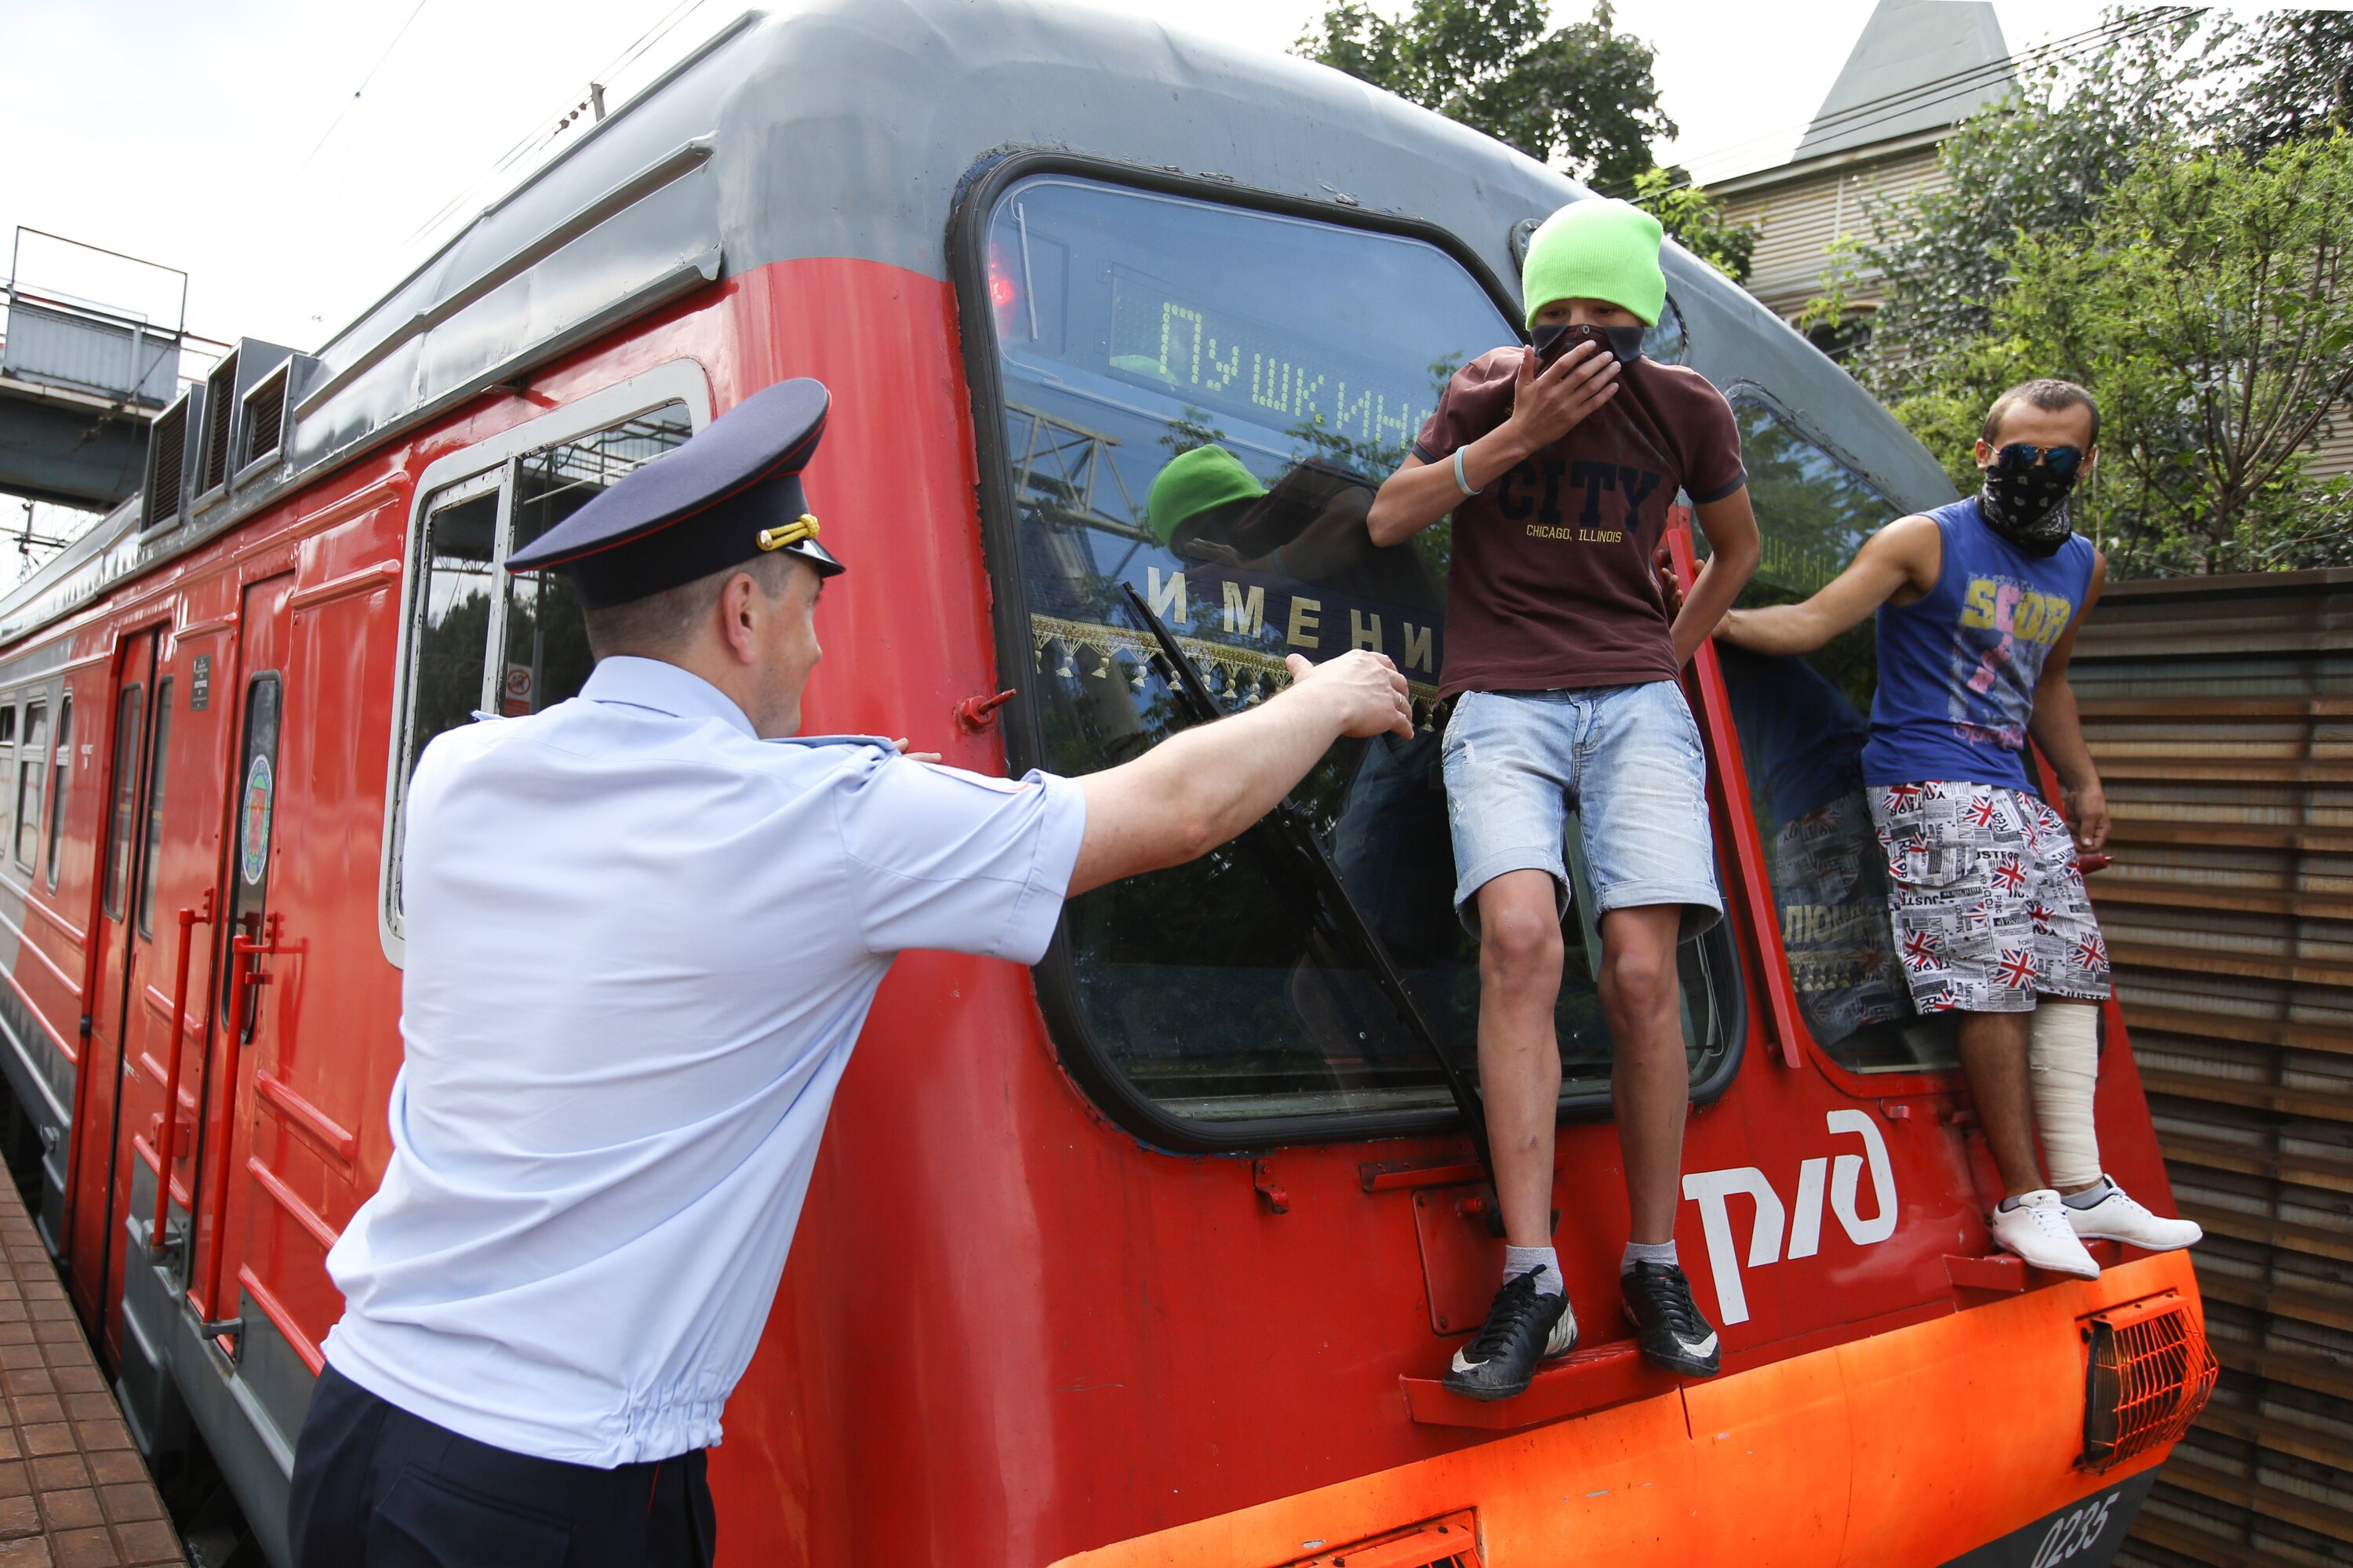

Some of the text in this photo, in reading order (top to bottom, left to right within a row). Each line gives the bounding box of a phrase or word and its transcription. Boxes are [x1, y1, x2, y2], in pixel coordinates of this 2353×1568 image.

[1497, 457, 1662, 533] CITY
[1526, 525, 1623, 544] CHICAGO, ILLINOIS
[1147, 566, 1433, 674] ИМЕНИ
[2031, 1491, 2121, 1568] 0235
